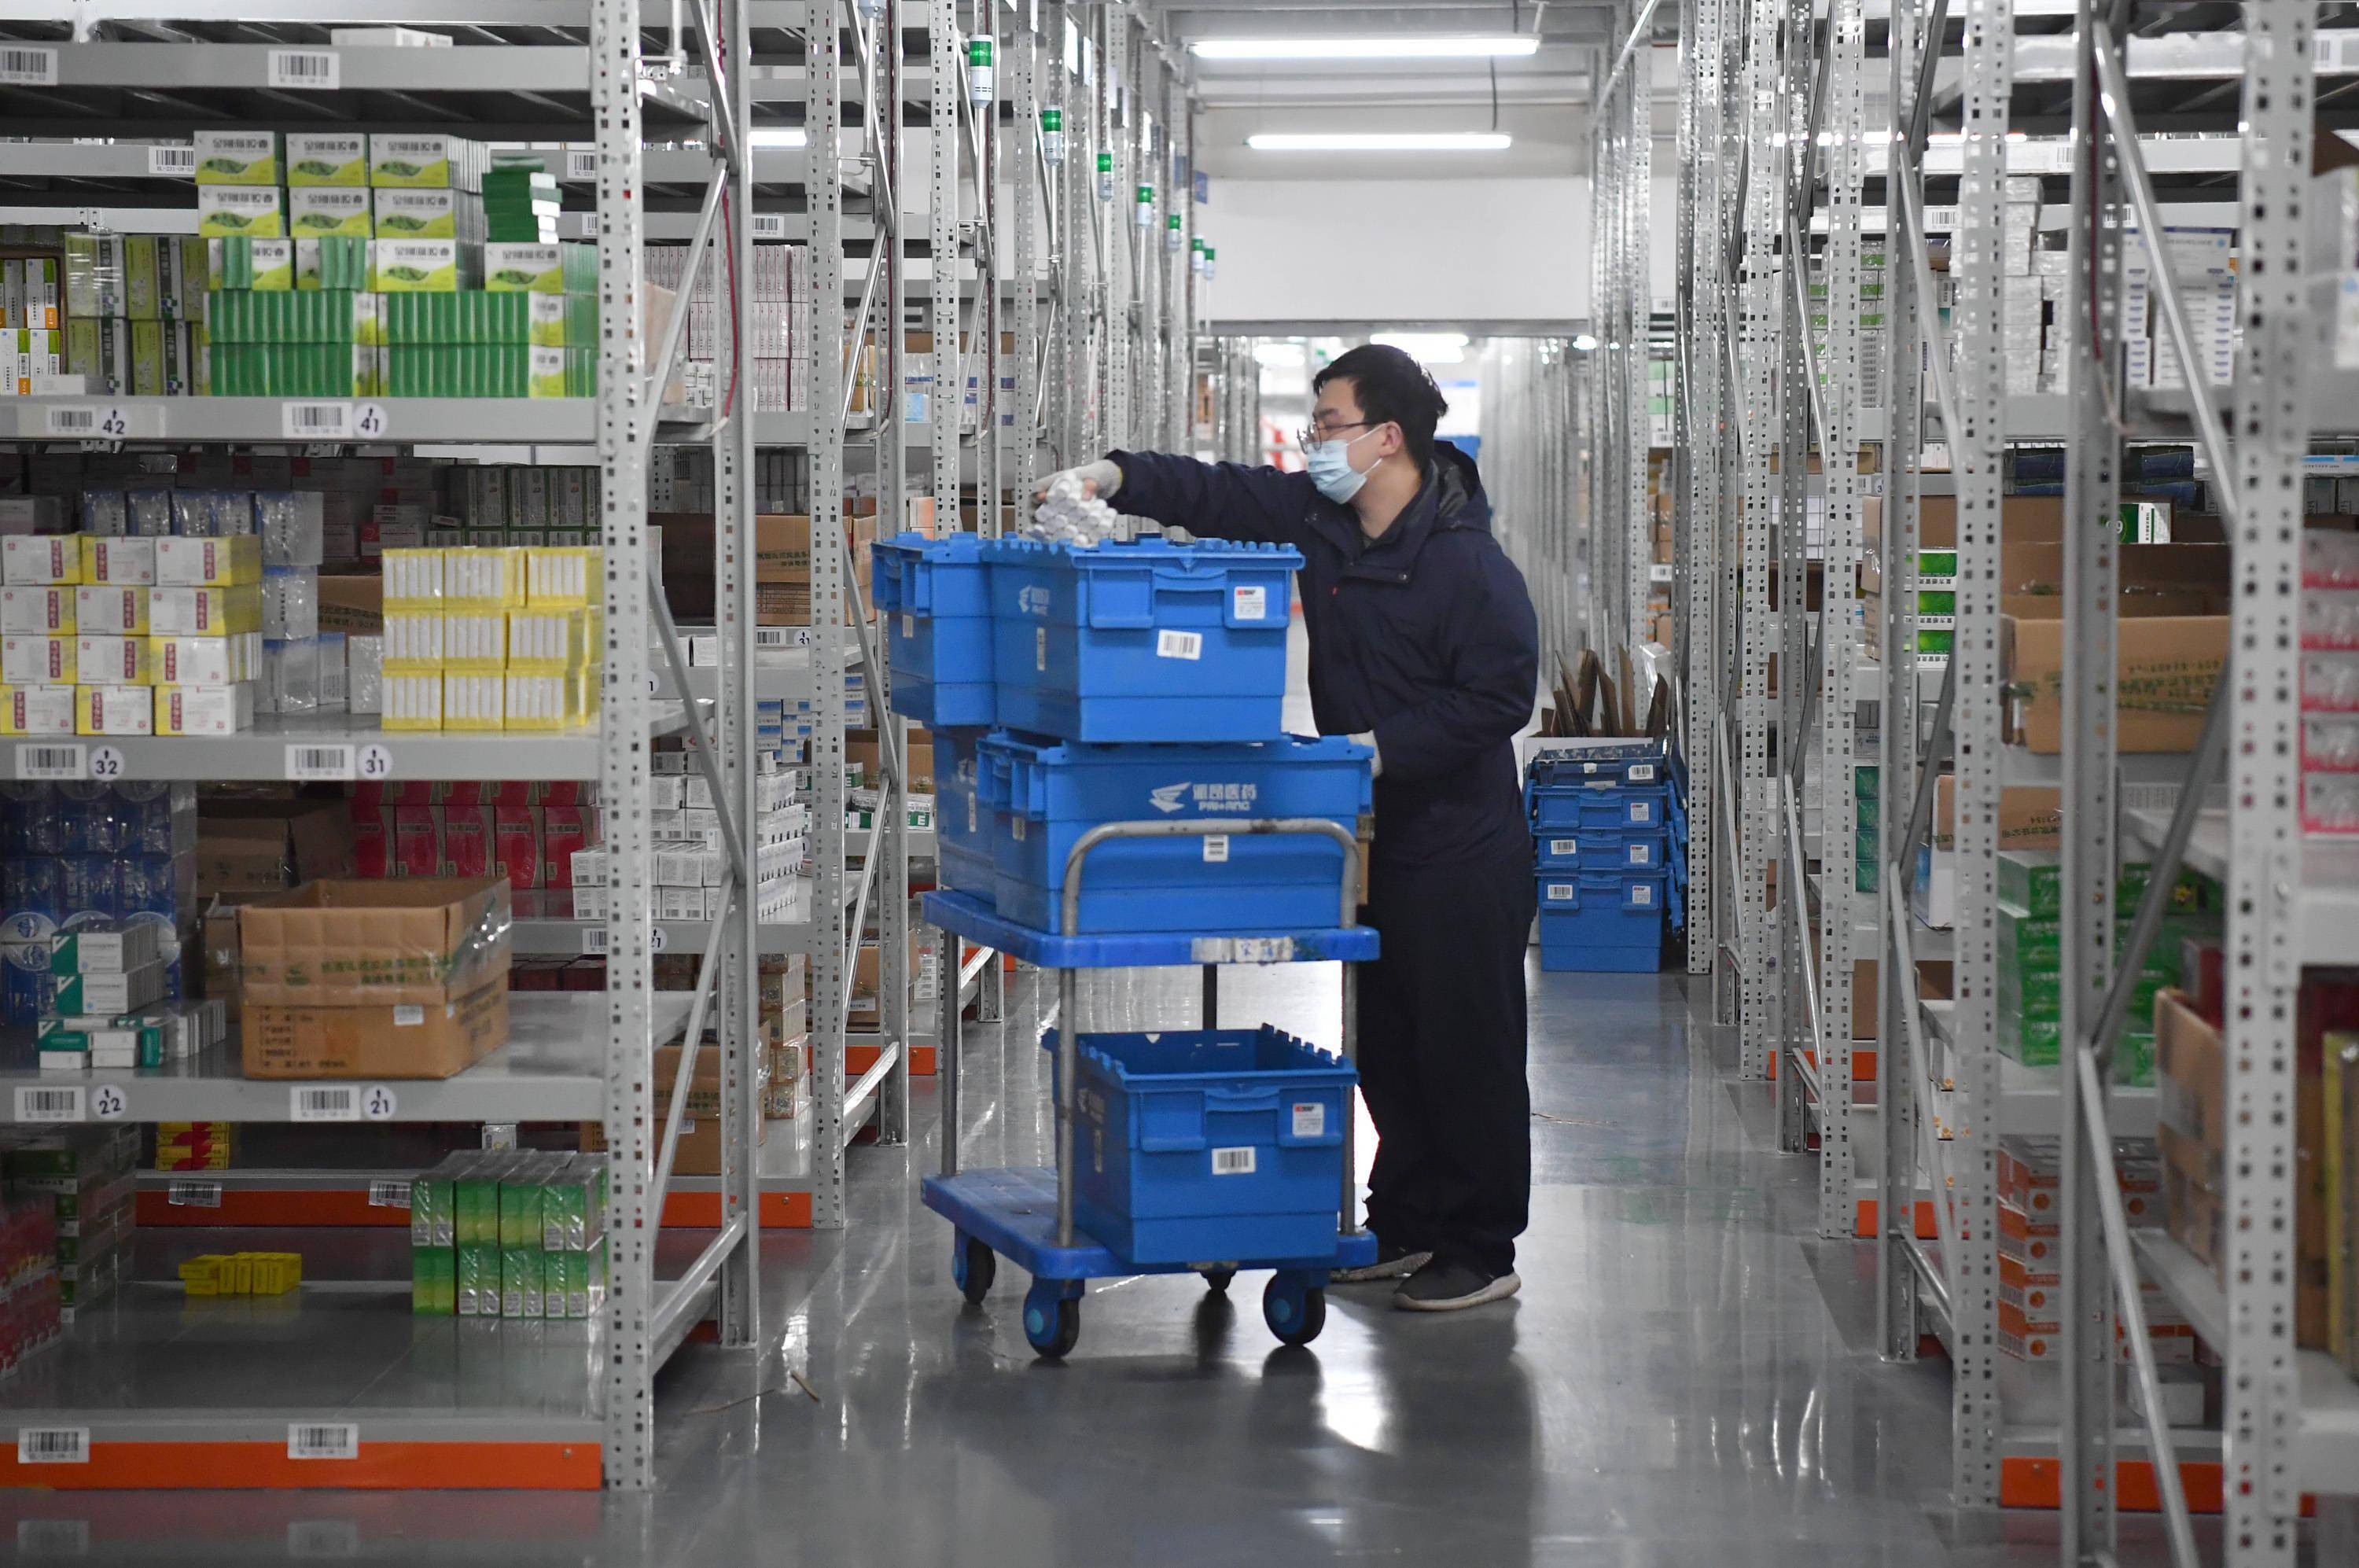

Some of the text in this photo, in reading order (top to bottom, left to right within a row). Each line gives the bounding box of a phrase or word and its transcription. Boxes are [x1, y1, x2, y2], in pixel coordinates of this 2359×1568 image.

[102, 419, 125, 435] 42
[361, 418, 378, 432] 41
[96, 760, 117, 775] 32
[366, 760, 384, 774] 31
[99, 1096, 121, 1115] 22
[370, 1100, 388, 1114] 21
